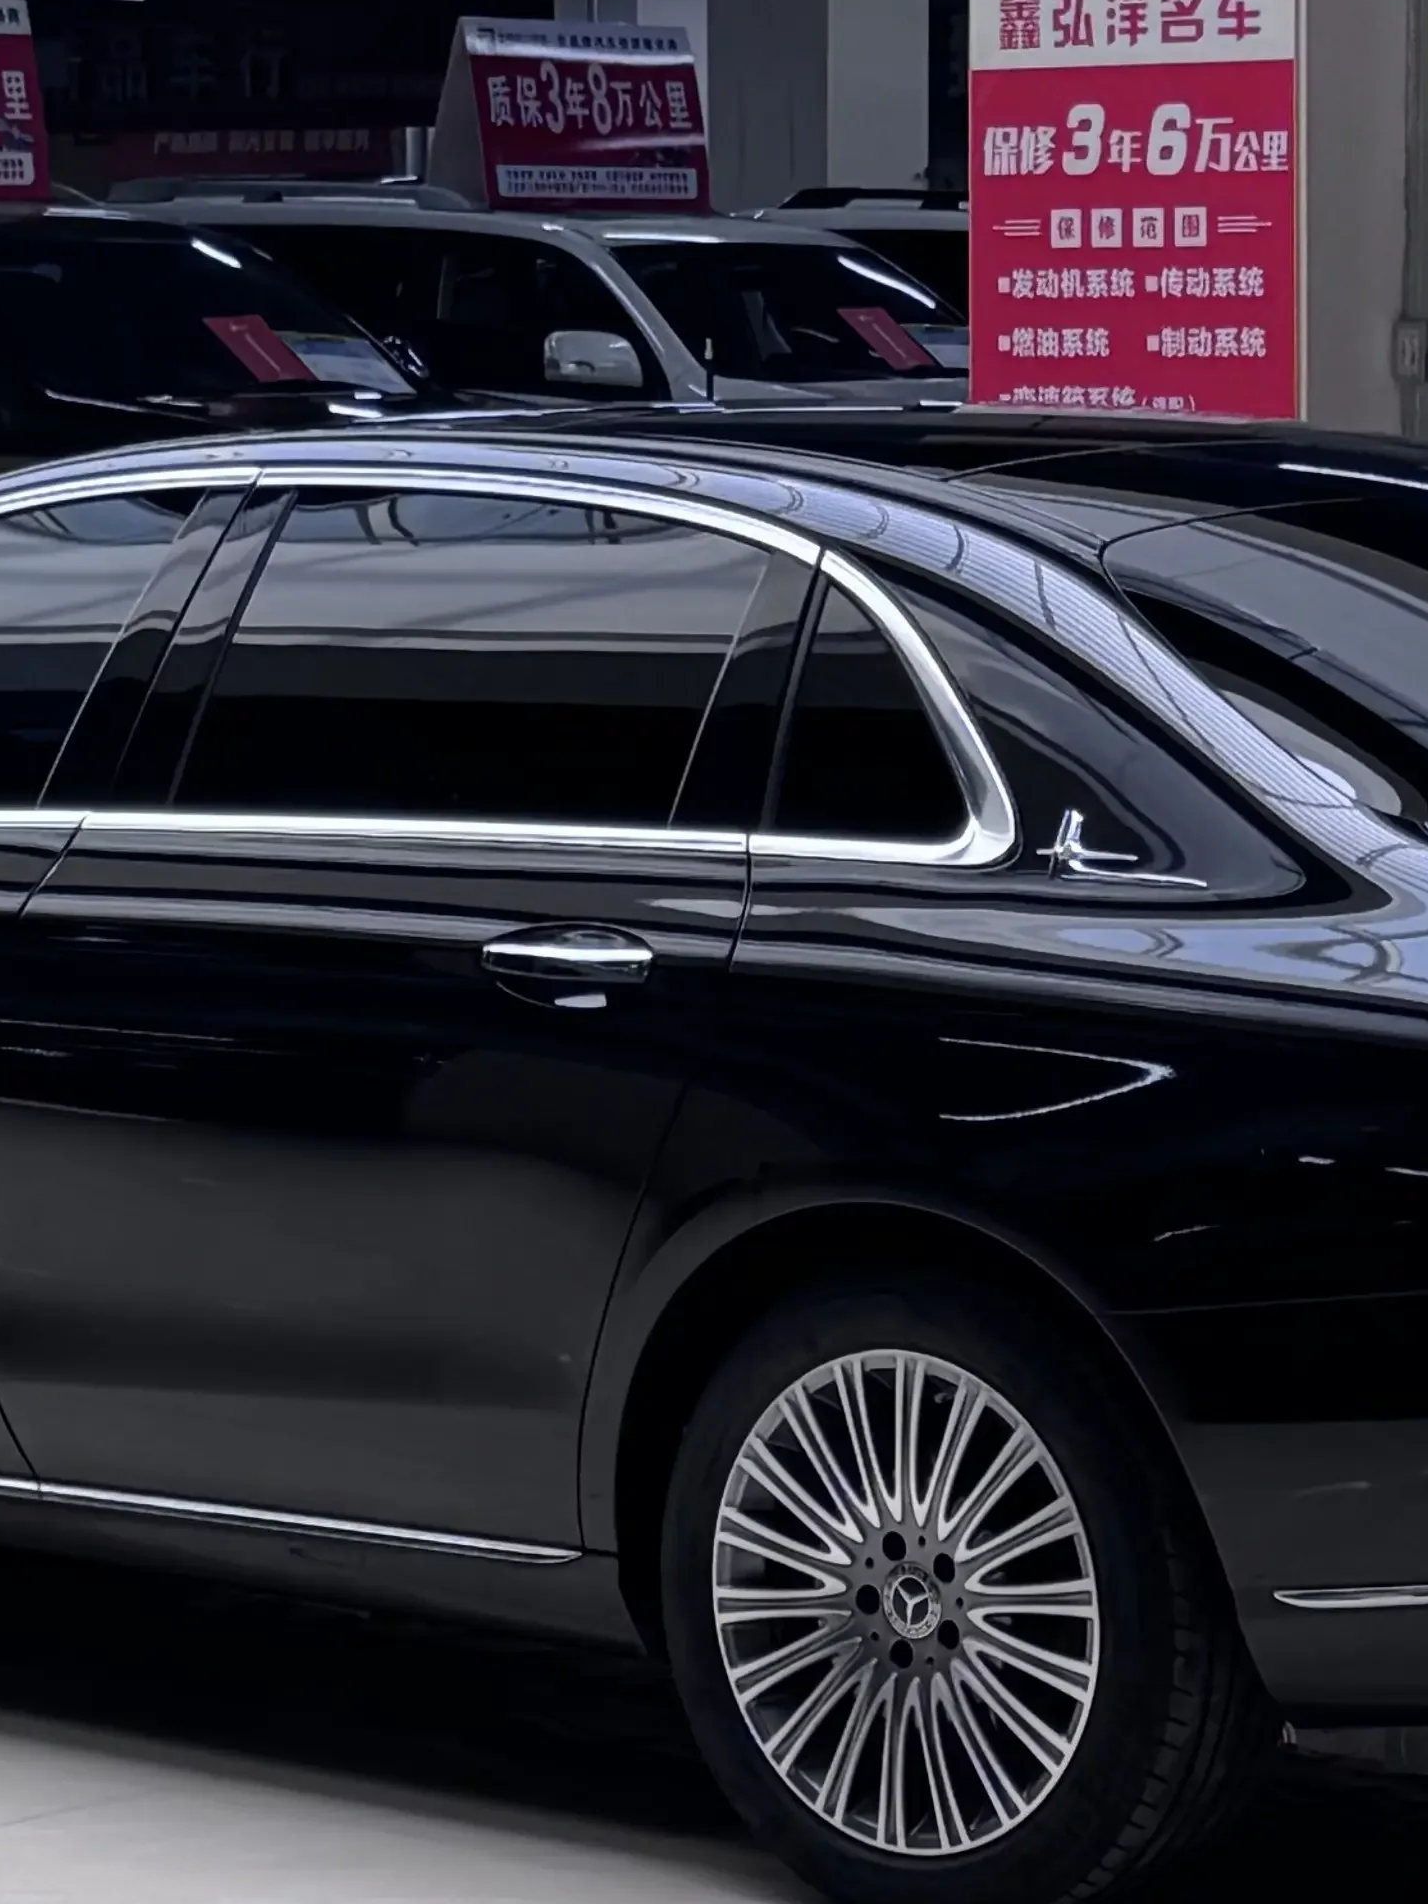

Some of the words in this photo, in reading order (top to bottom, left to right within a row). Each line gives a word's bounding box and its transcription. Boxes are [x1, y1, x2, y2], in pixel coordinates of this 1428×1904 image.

[486, 60, 693, 135] 质保3年8万公里
[983, 103, 1289, 176] 保修3年6万公里
[1012, 267, 1135, 299] 发动机系统
[1160, 266, 1265, 299] 传动系统
[1012, 326, 1110, 359] 燃油系统
[1160, 326, 1267, 359] 制动系统
